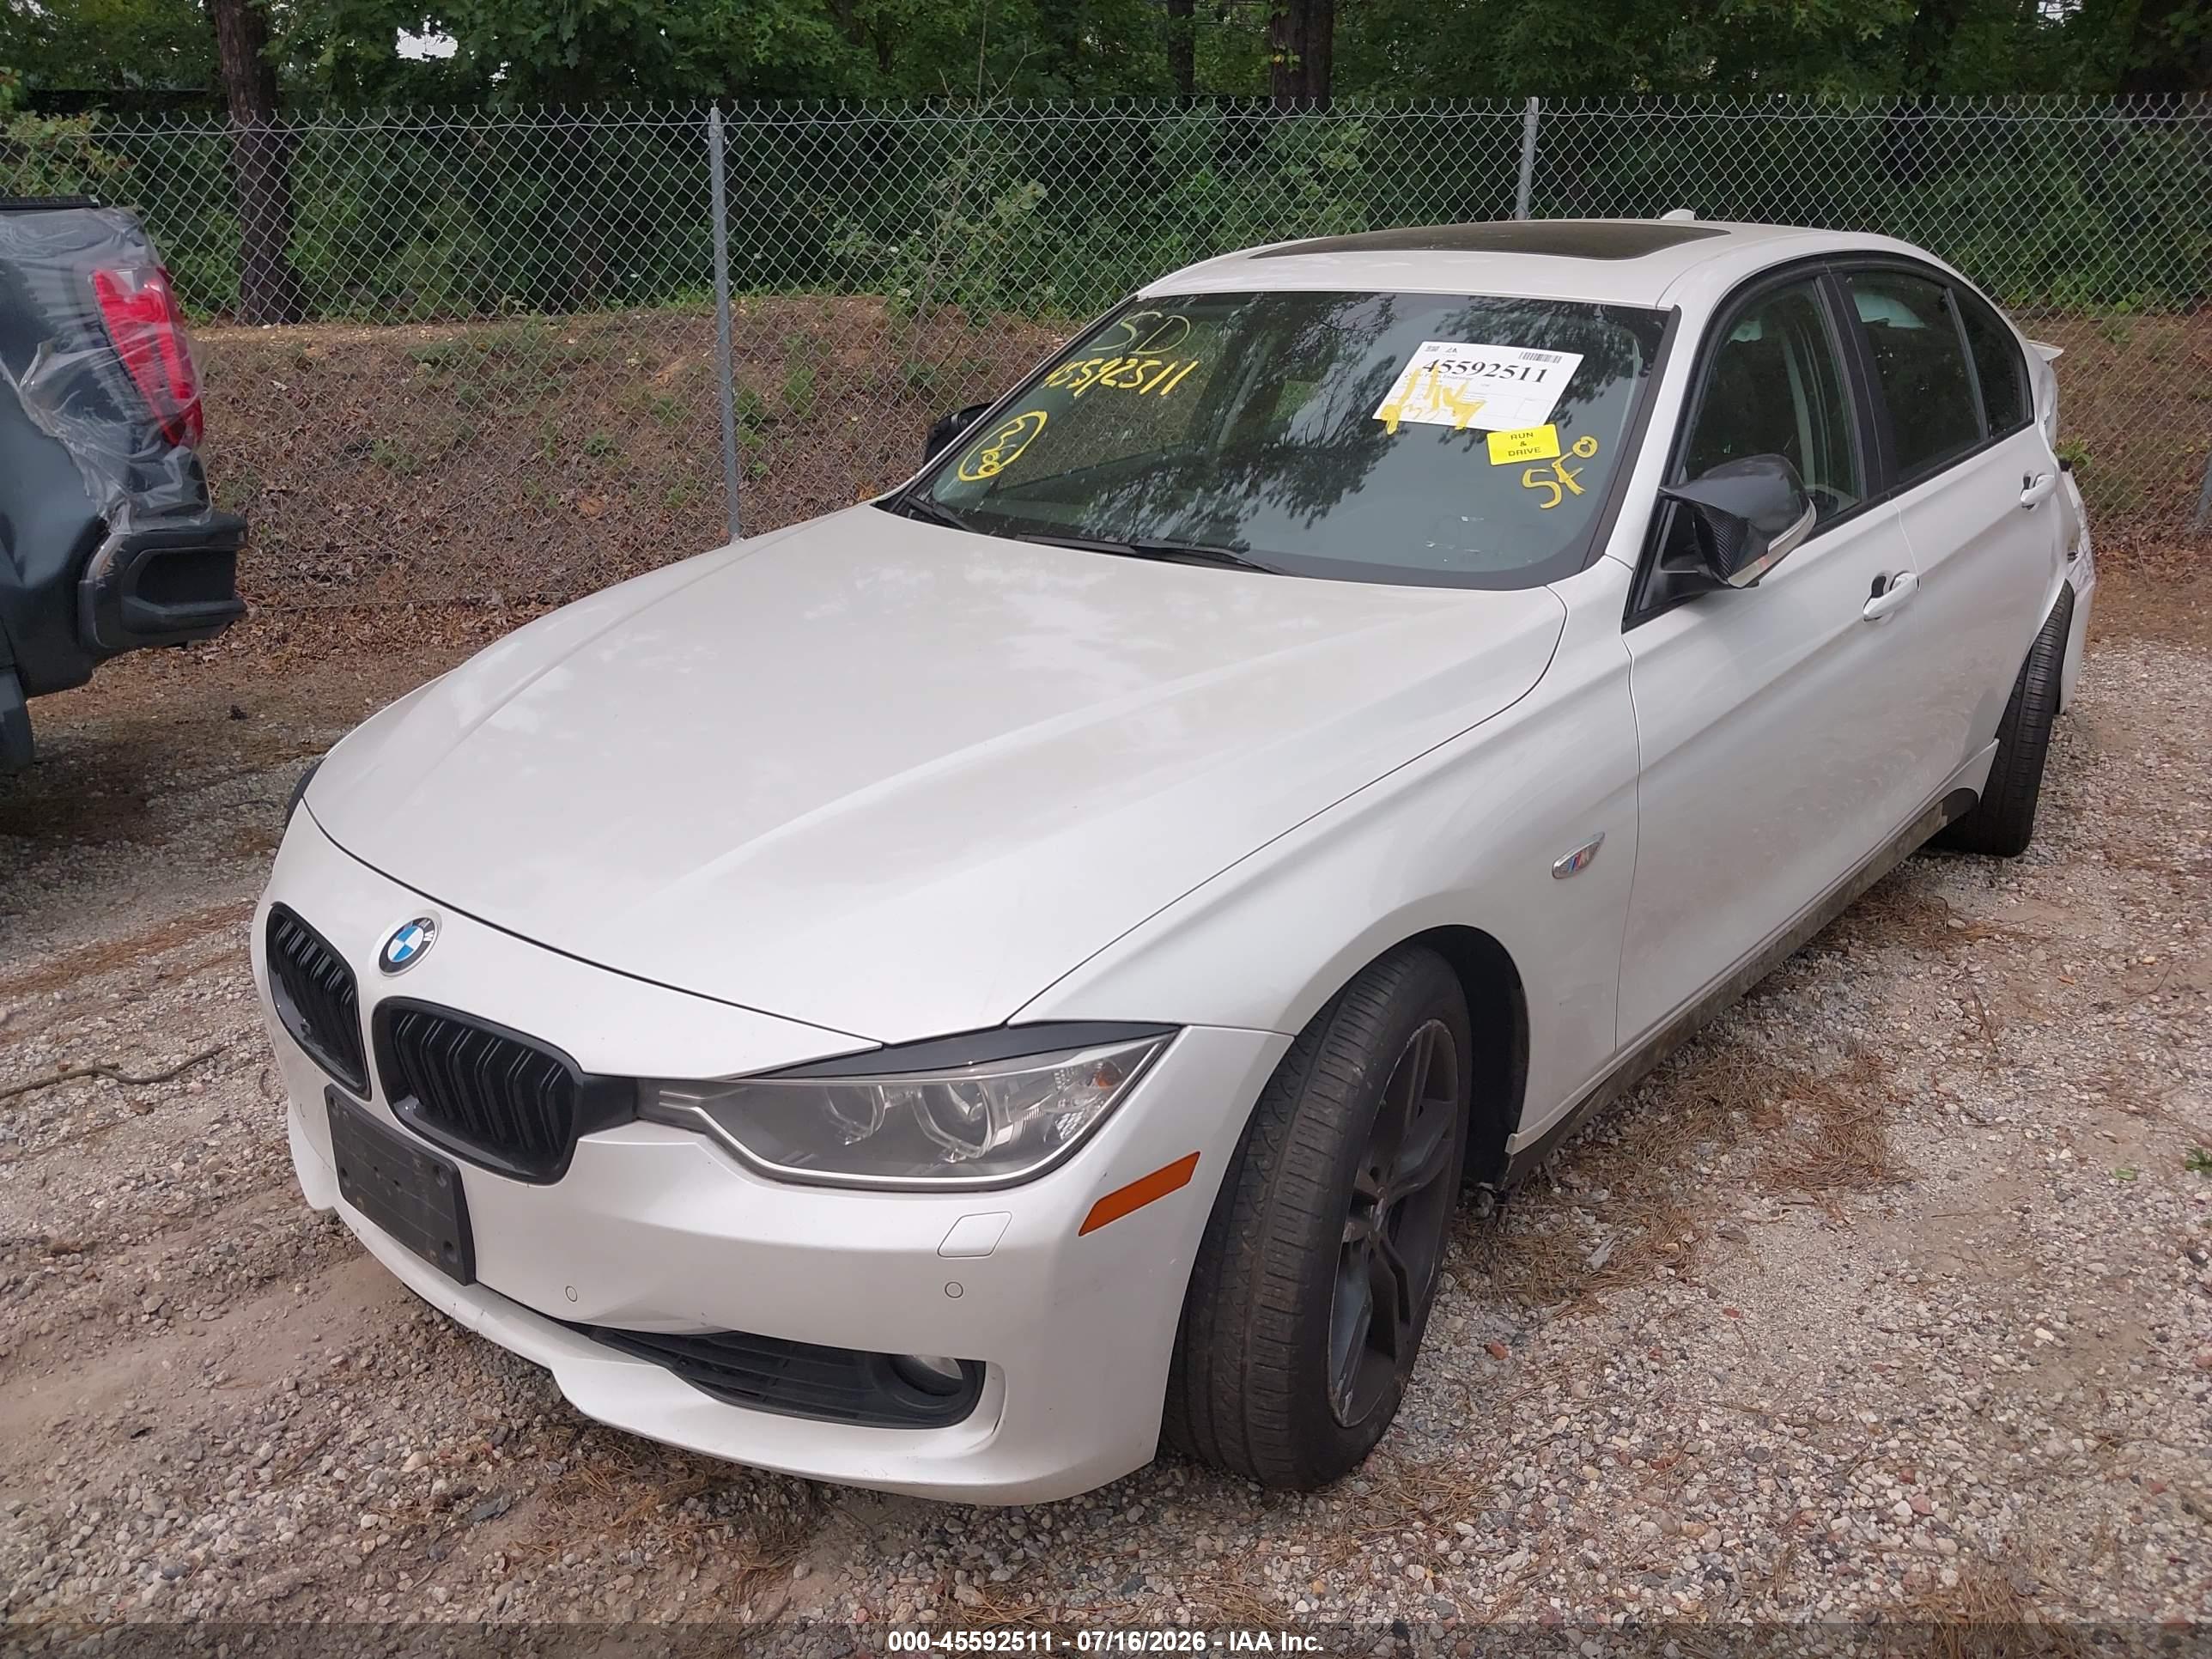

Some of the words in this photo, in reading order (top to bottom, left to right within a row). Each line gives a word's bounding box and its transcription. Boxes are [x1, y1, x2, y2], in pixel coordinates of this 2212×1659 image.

[1091, 311, 1191, 355] SD
[1422, 359, 1548, 383] 45592511
[1508, 447, 1541, 457] DRIVE
